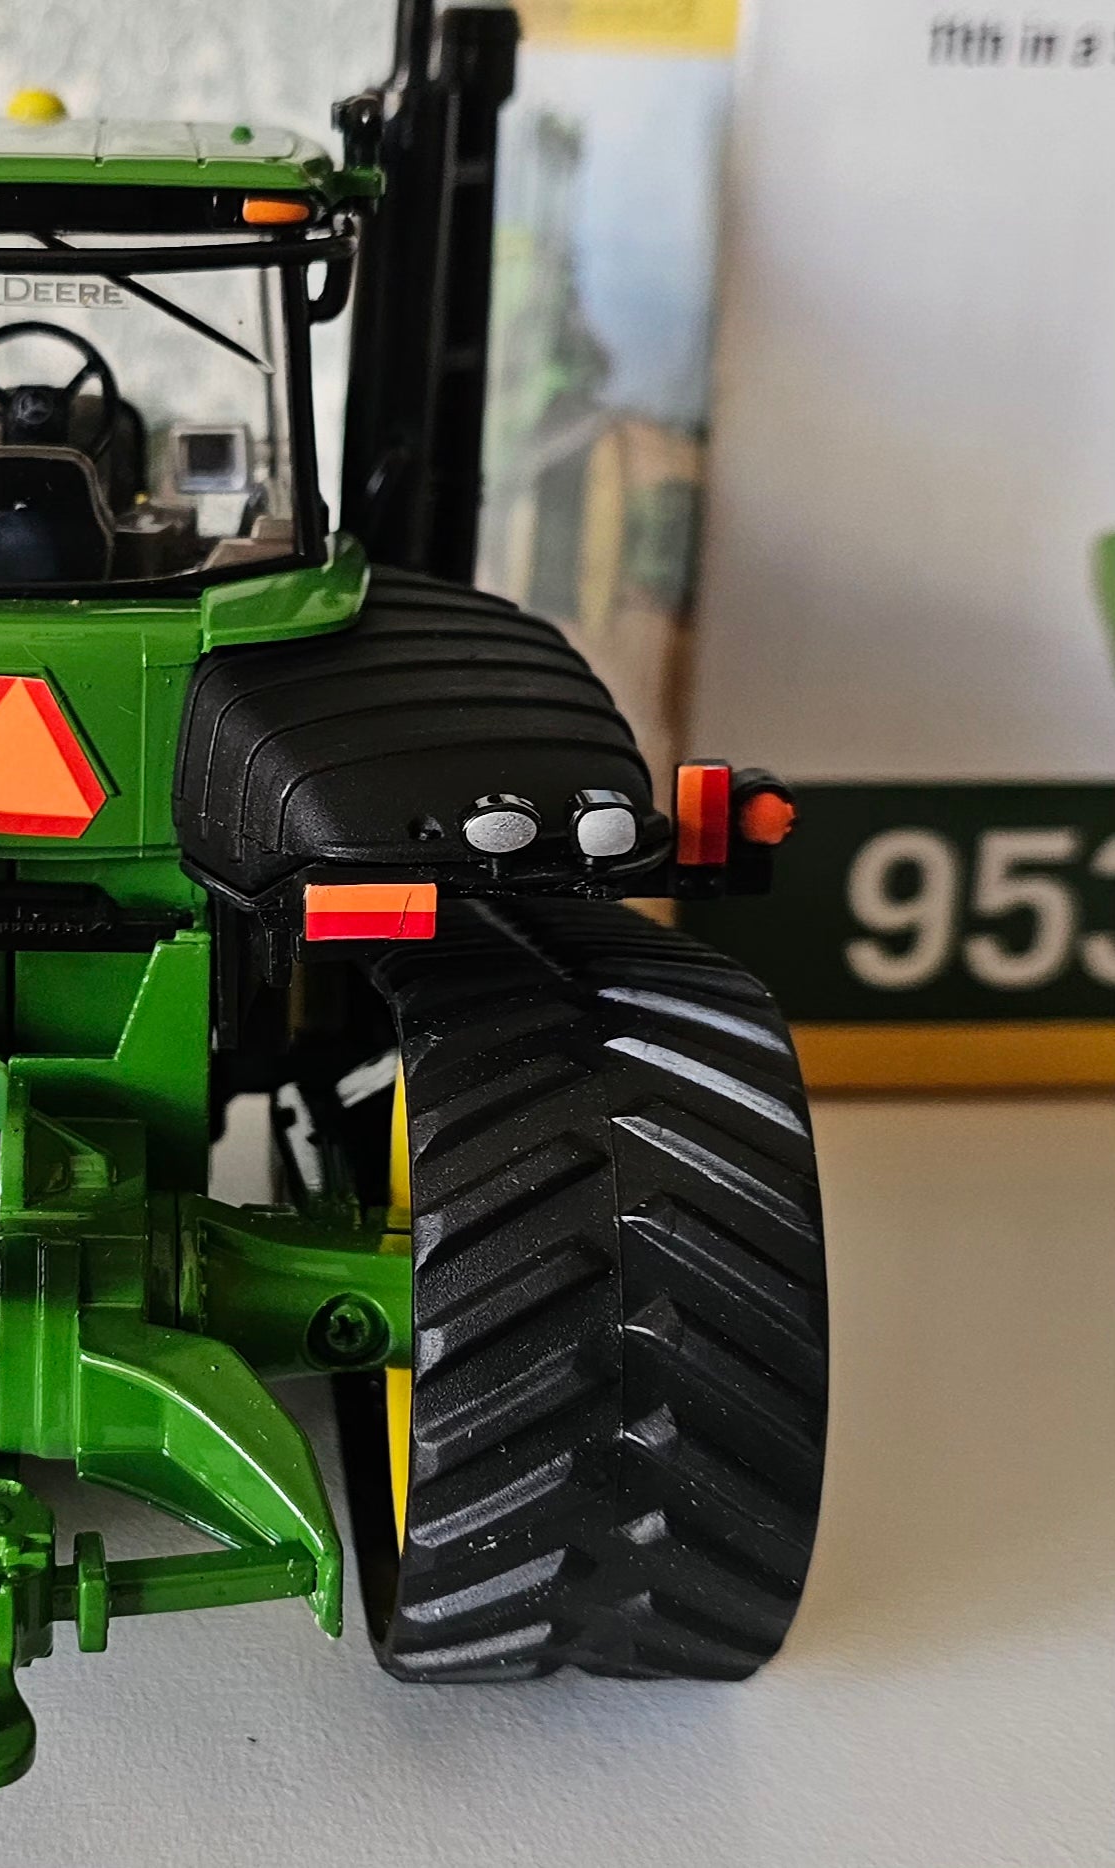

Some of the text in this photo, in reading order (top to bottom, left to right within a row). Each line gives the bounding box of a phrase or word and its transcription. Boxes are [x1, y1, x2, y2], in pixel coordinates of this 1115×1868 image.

[1020, 22, 1058, 67] in
[1070, 32, 1098, 68] a
[3, 277, 124, 305] DEERE
[845, 828, 1115, 990] 95
